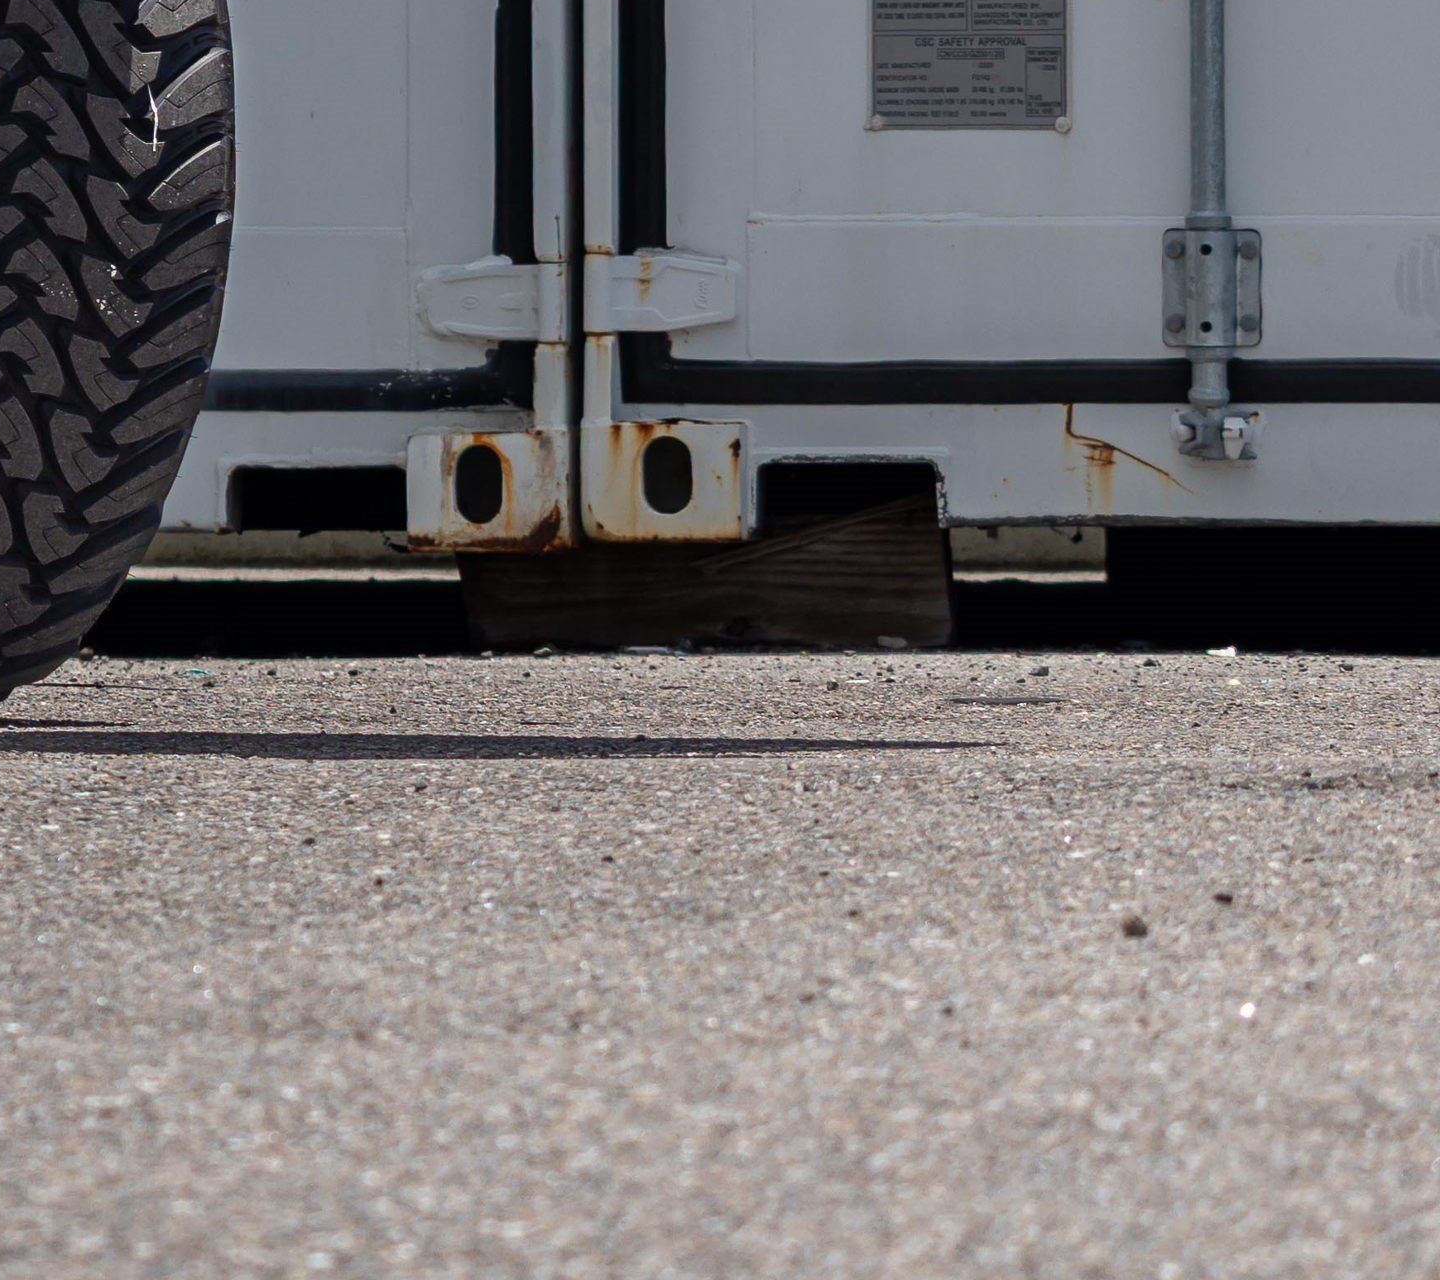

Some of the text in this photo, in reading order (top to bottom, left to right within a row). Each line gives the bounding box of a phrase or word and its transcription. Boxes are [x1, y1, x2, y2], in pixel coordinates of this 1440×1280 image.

[914, 37, 1027, 47] CSC SAFETY APPROVAL
